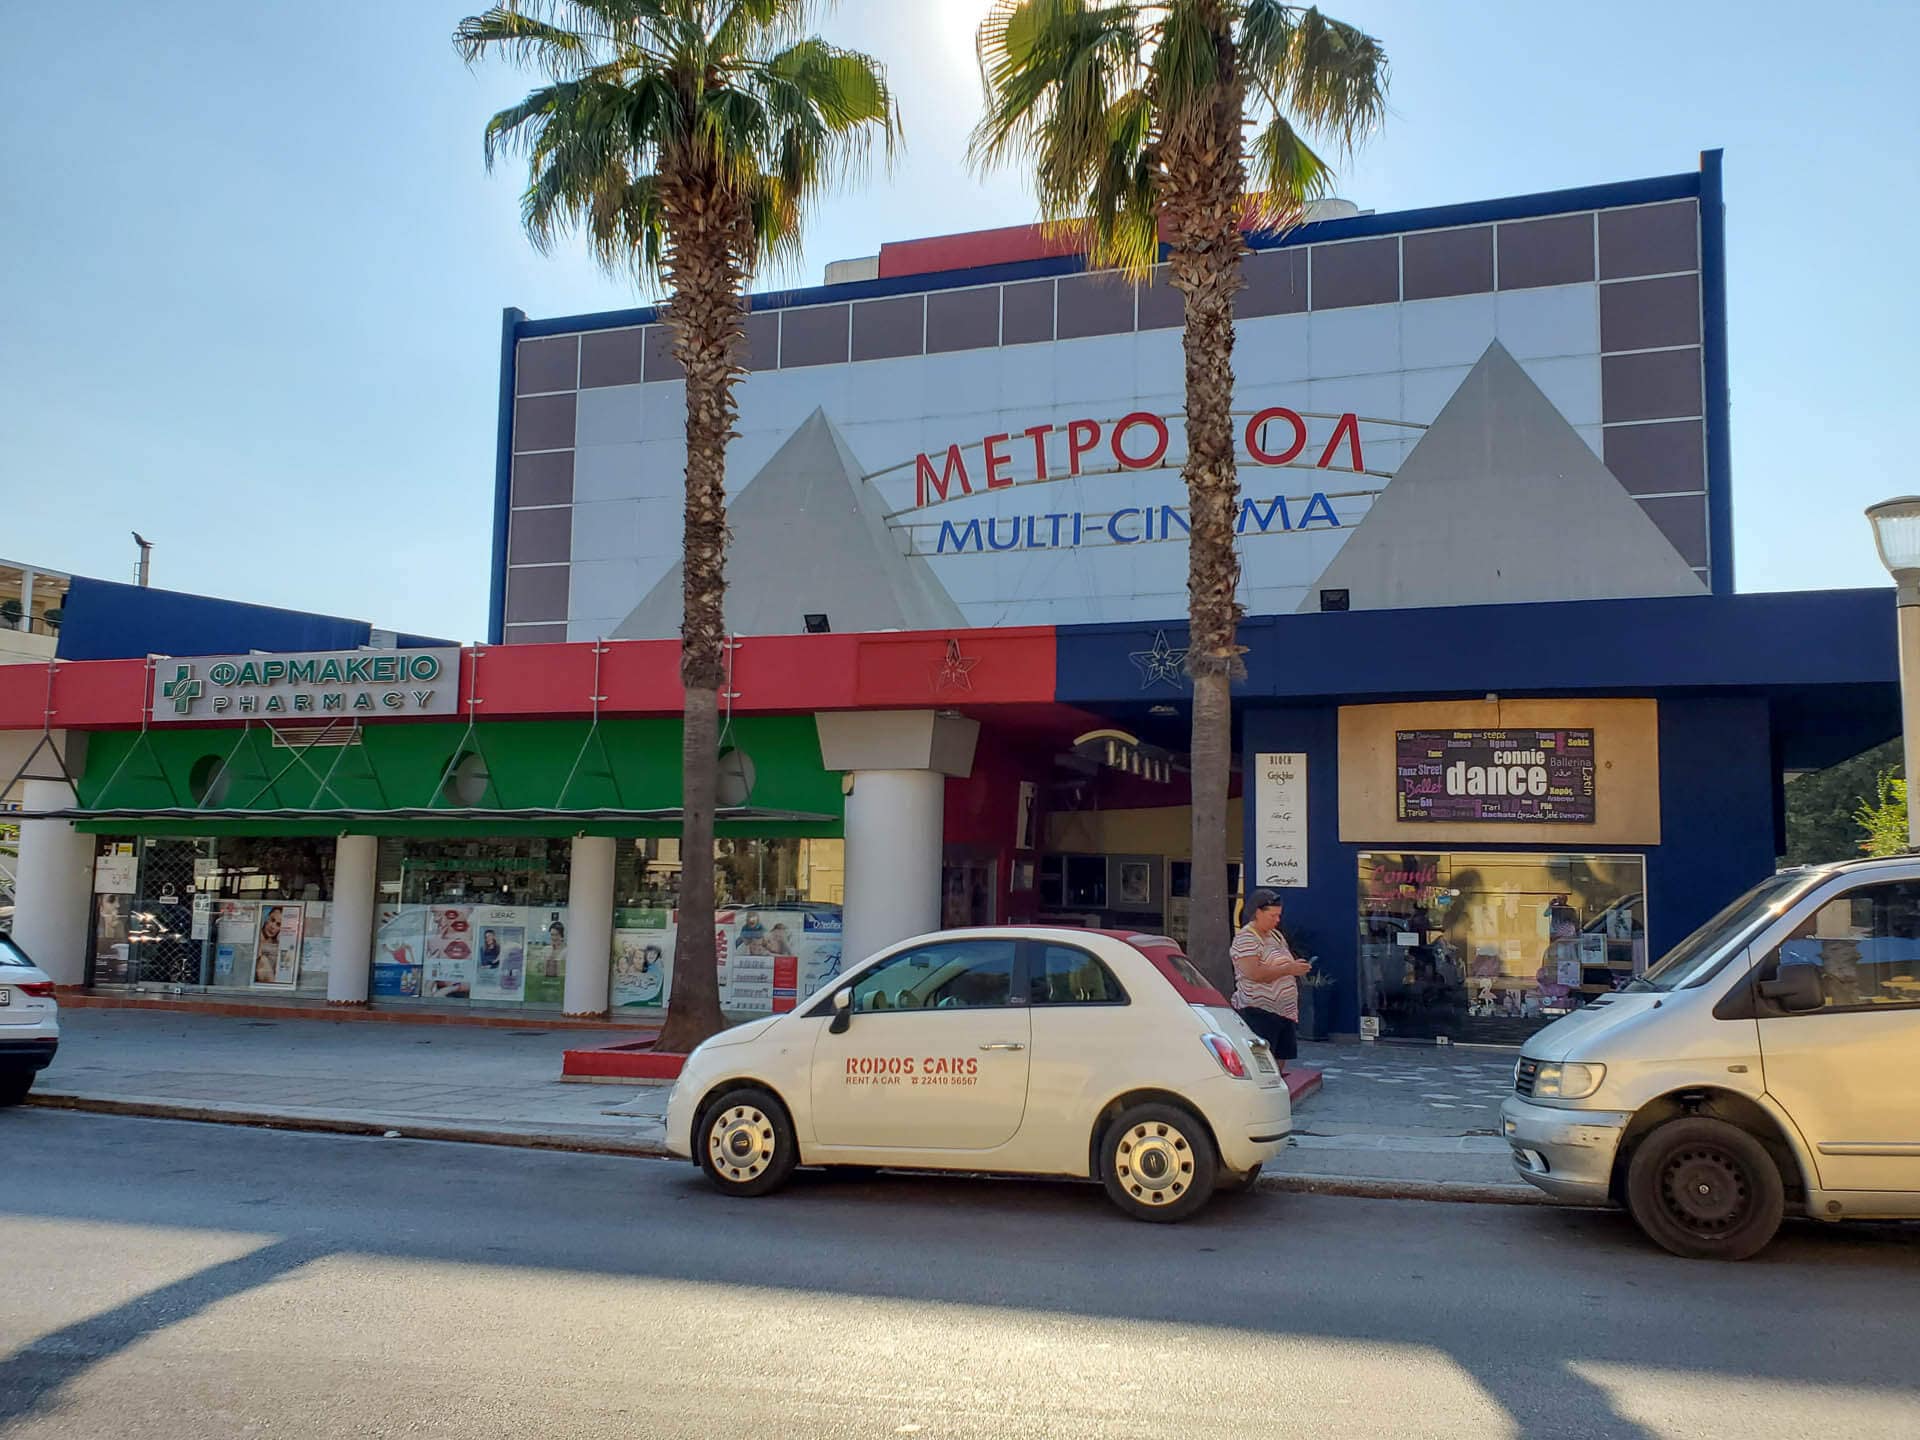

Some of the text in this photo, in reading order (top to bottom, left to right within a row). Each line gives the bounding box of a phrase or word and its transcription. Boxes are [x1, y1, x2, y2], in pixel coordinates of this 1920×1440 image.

[914, 406, 1367, 508] ΜΕΤΡΟΟΛ
[936, 492, 1341, 554] MULTI-CINMA
[208, 654, 440, 687] ΦΑΡΜΑΚΕΙΟ
[212, 689, 435, 713] PHARMACY
[1493, 749, 1546, 765] connie
[1550, 757, 1592, 767] Ballerina
[1403, 777, 1442, 797] Ballet
[1446, 761, 1548, 796] dance
[846, 1057, 978, 1074] RODOS CARS
[846, 1076, 870, 1085] RENT
[872, 1076, 879, 1085] A
[881, 1076, 901, 1085] CAR
[921, 1076, 948, 1085] 22410
